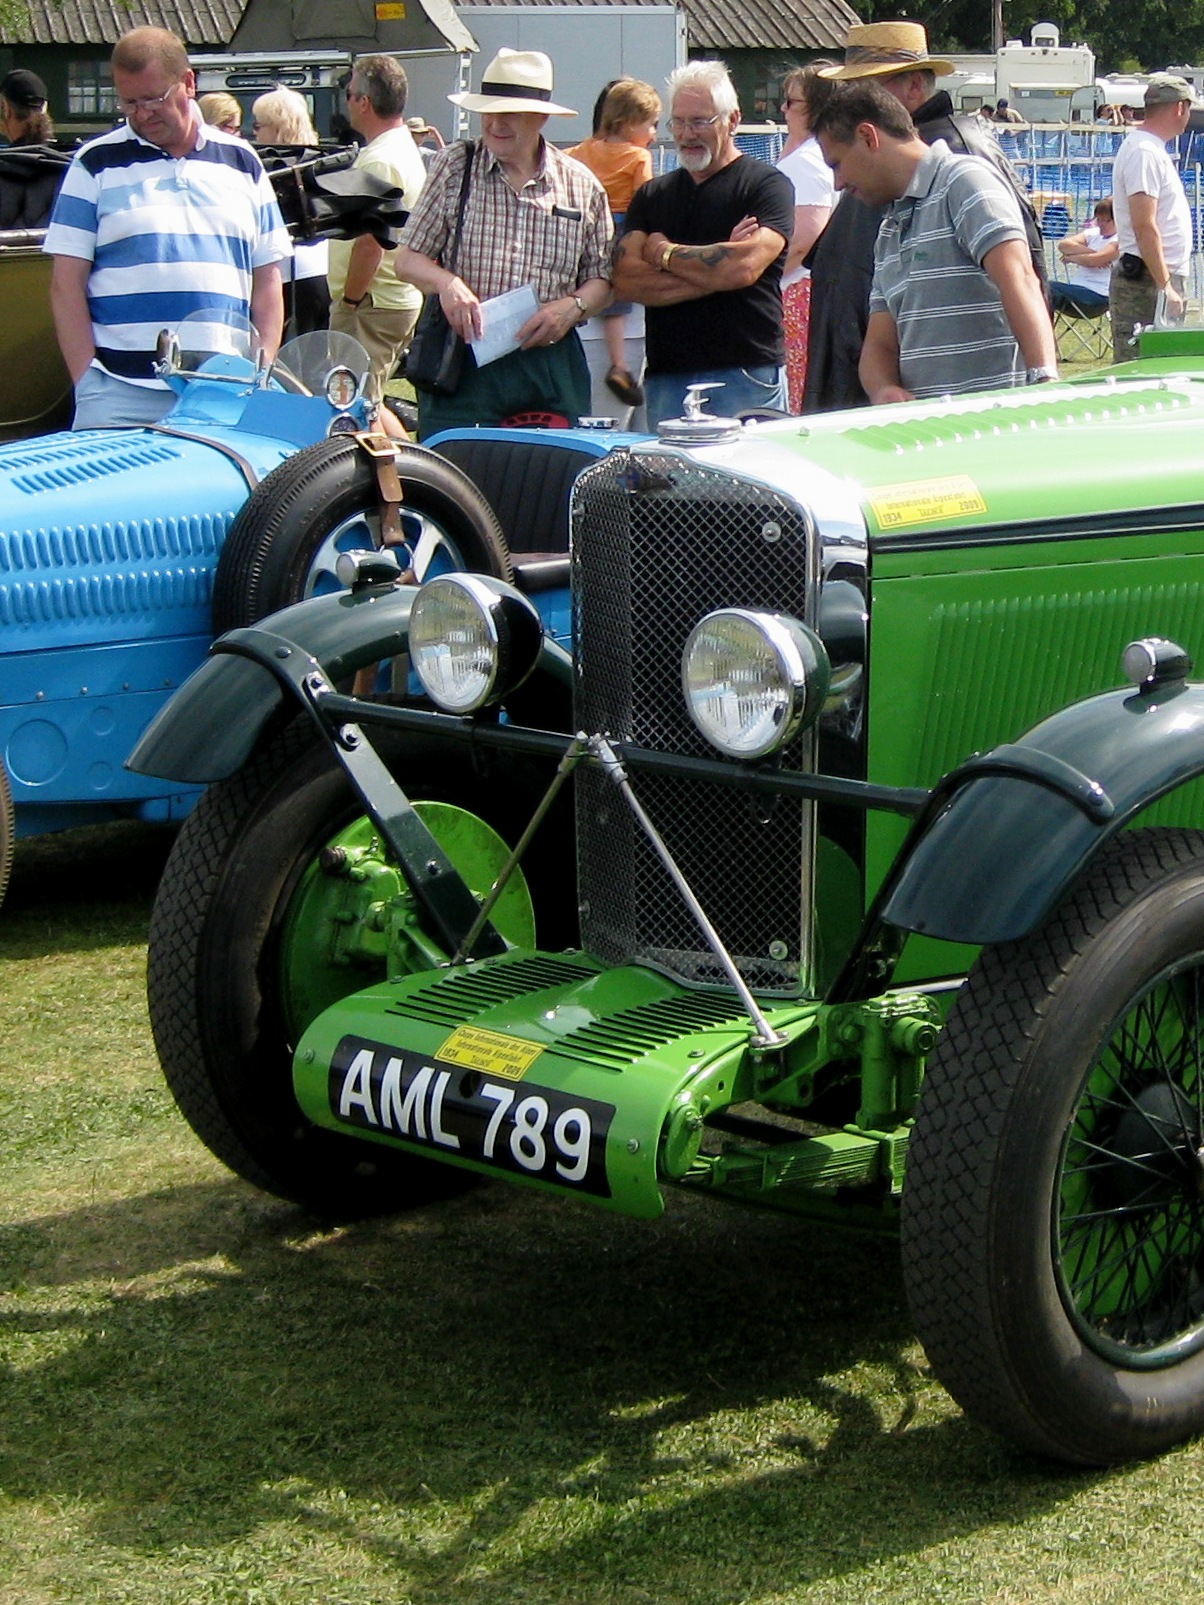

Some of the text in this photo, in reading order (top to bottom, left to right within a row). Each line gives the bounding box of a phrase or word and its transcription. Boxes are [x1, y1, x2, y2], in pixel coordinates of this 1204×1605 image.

[883, 512, 902, 523] 1934
[339, 1049, 592, 1182] AML 789
